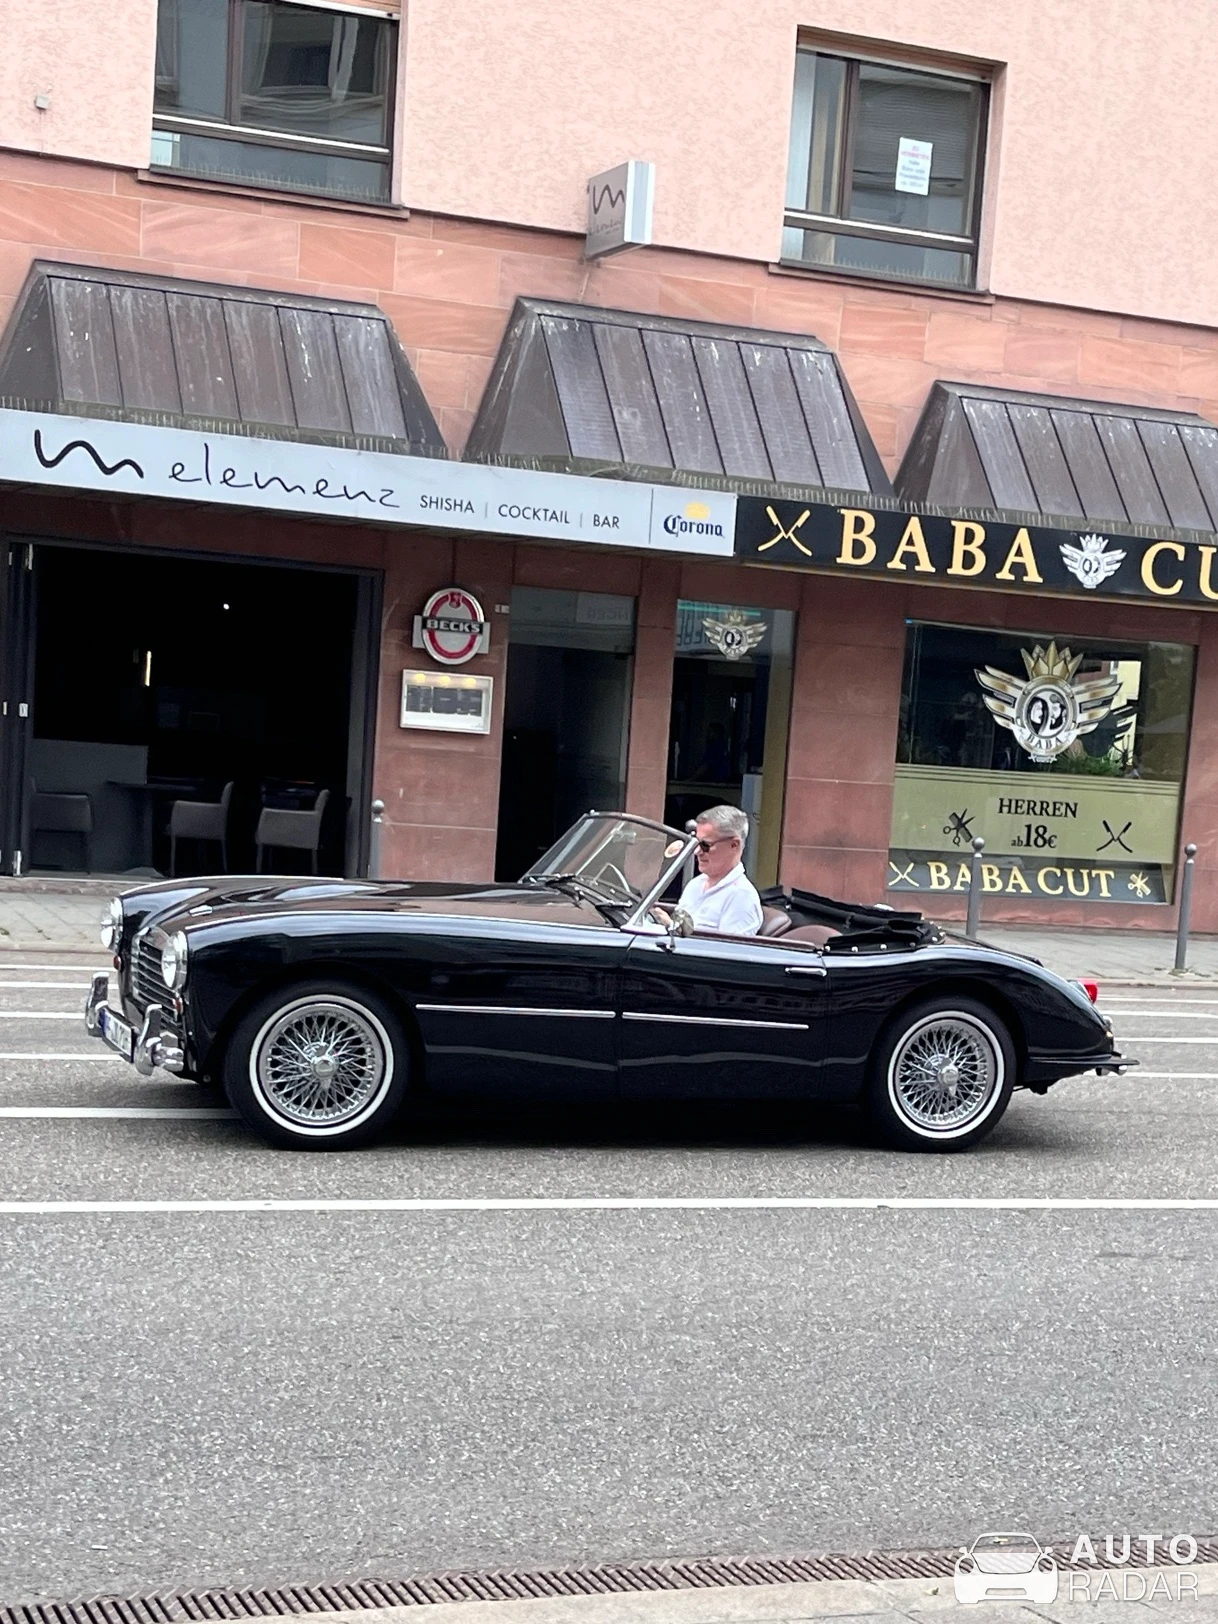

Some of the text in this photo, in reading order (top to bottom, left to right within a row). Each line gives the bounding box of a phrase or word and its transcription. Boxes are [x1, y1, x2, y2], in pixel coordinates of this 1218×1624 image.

[419, 494, 620, 530] SHISHA COCKTAIL BAR
[663, 513, 725, 538] Corona
[836, 508, 1043, 584] BABA
[997, 797, 1079, 818] HERREN
